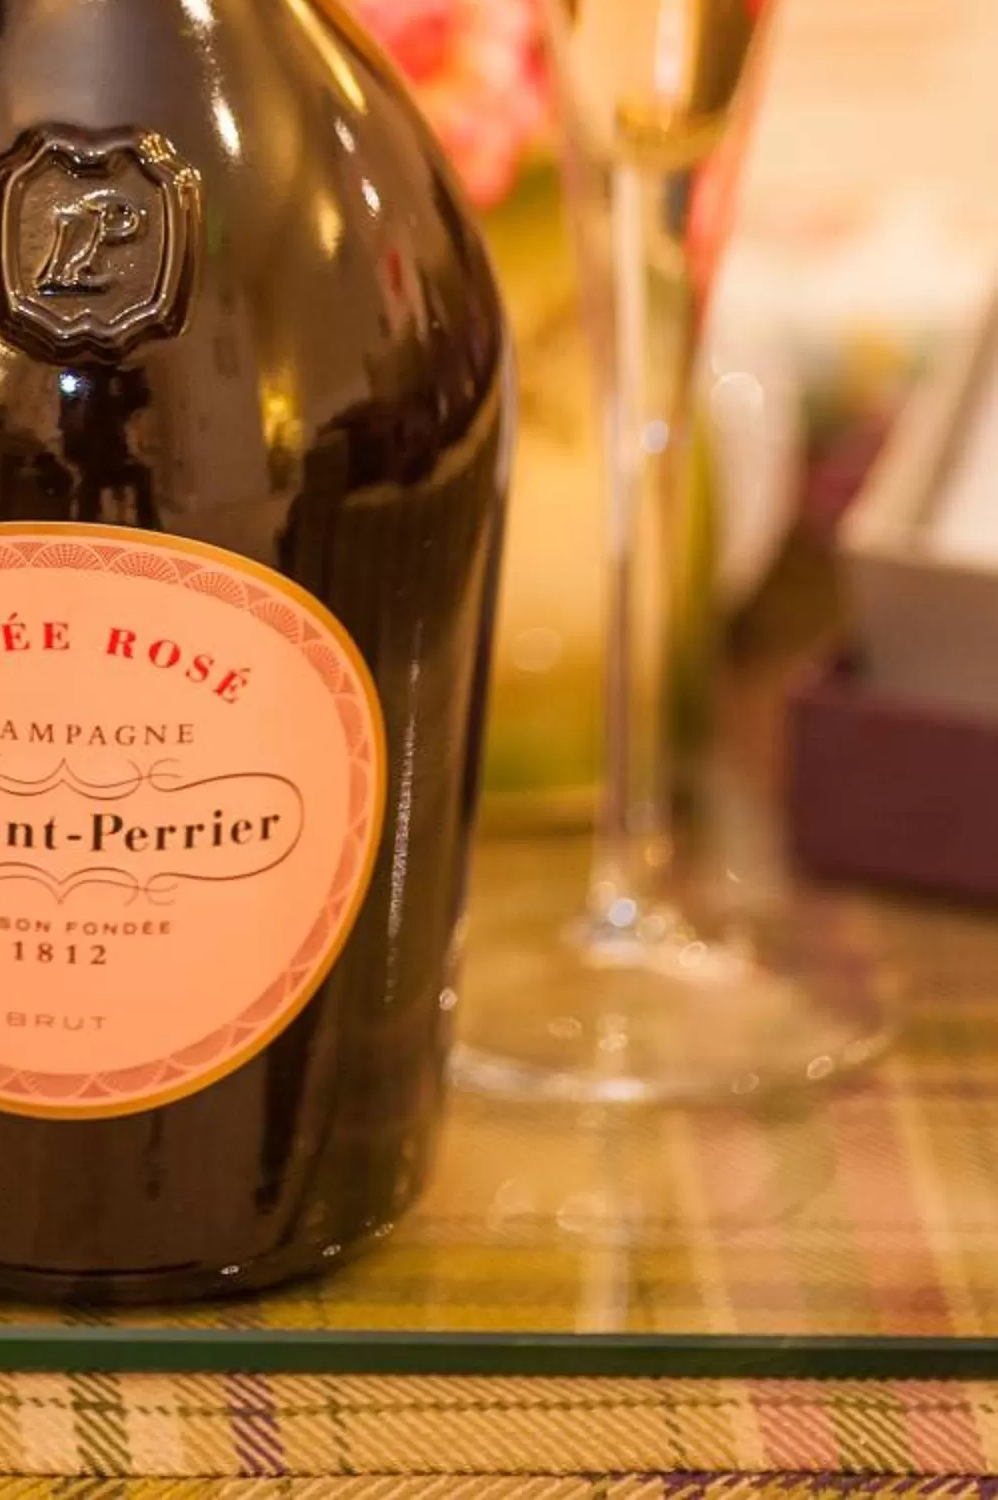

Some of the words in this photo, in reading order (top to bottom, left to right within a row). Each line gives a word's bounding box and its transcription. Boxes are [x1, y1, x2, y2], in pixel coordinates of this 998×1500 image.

[106, 627, 253, 704] ROSÉ
[65, 920, 172, 936] FONDÉE
[12, 941, 108, 965] 1812
[5, 1011, 108, 1031] BRUT
